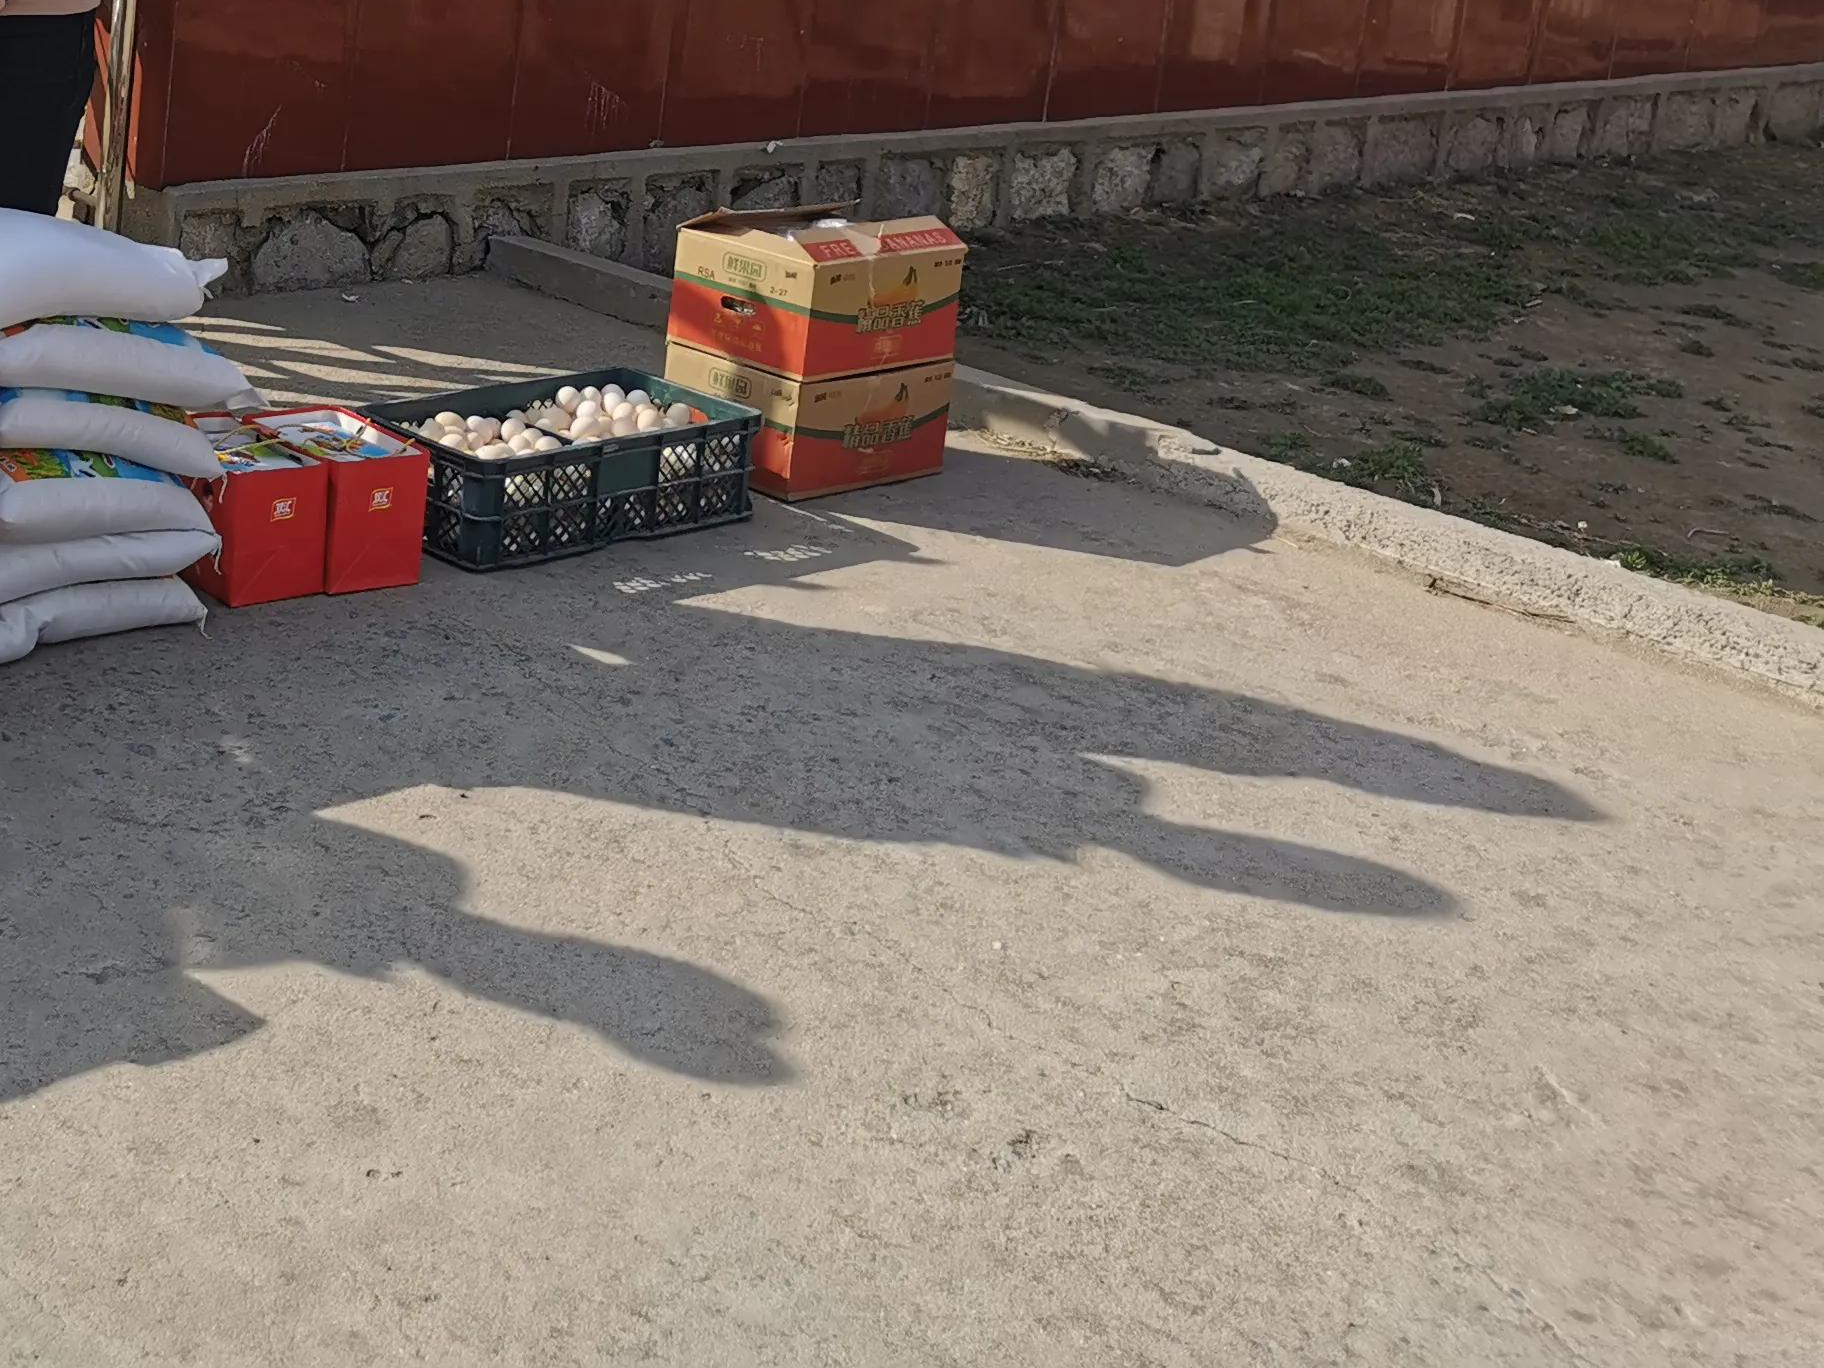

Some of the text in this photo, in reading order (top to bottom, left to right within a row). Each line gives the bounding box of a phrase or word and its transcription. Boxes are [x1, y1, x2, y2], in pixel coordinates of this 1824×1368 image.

[880, 231, 948, 253] ANANAS
[697, 266, 715, 280] RSA
[857, 299, 926, 334] 精品香蕉
[843, 415, 914, 450] 精品香蕉
